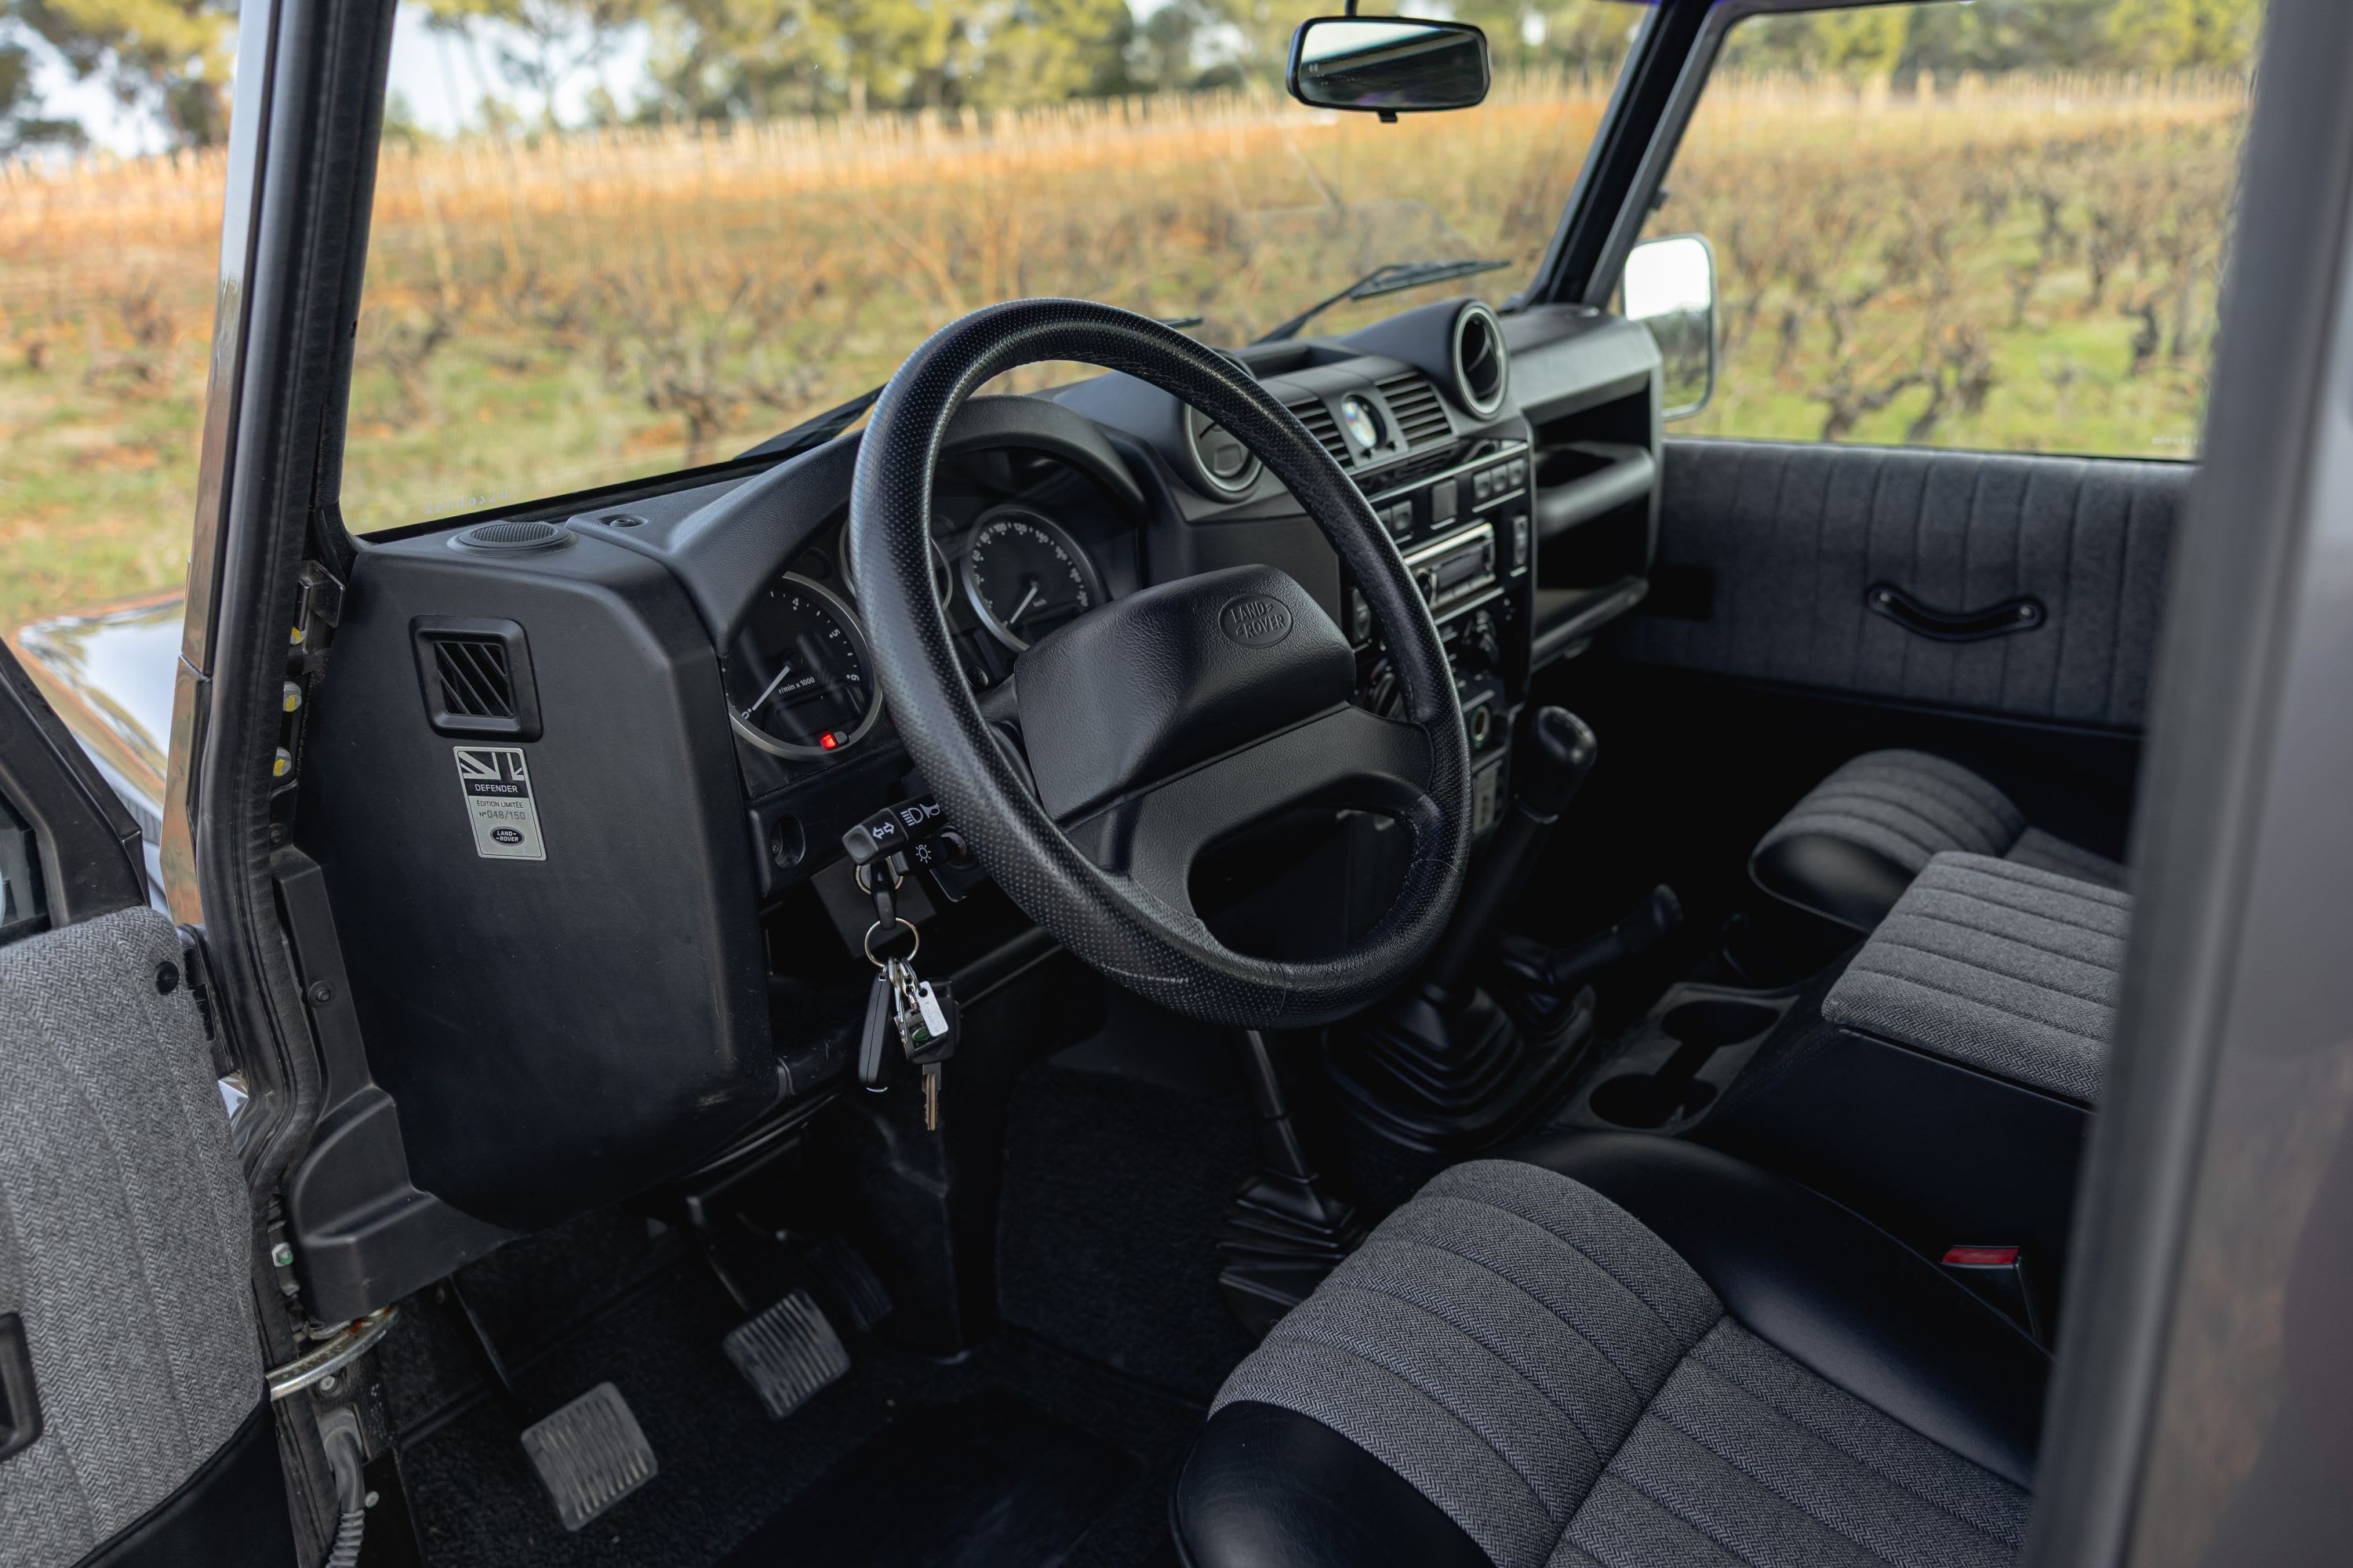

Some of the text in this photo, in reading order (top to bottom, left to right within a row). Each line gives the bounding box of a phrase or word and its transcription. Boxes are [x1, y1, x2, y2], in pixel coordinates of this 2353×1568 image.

[792, 598, 799, 606] 4
[831, 628, 841, 638] 5
[778, 684, 796, 694] r/min
[800, 676, 815, 686] 1000
[475, 784, 518, 793] DEFENDER
[477, 799, 500, 808] ÉDITION
